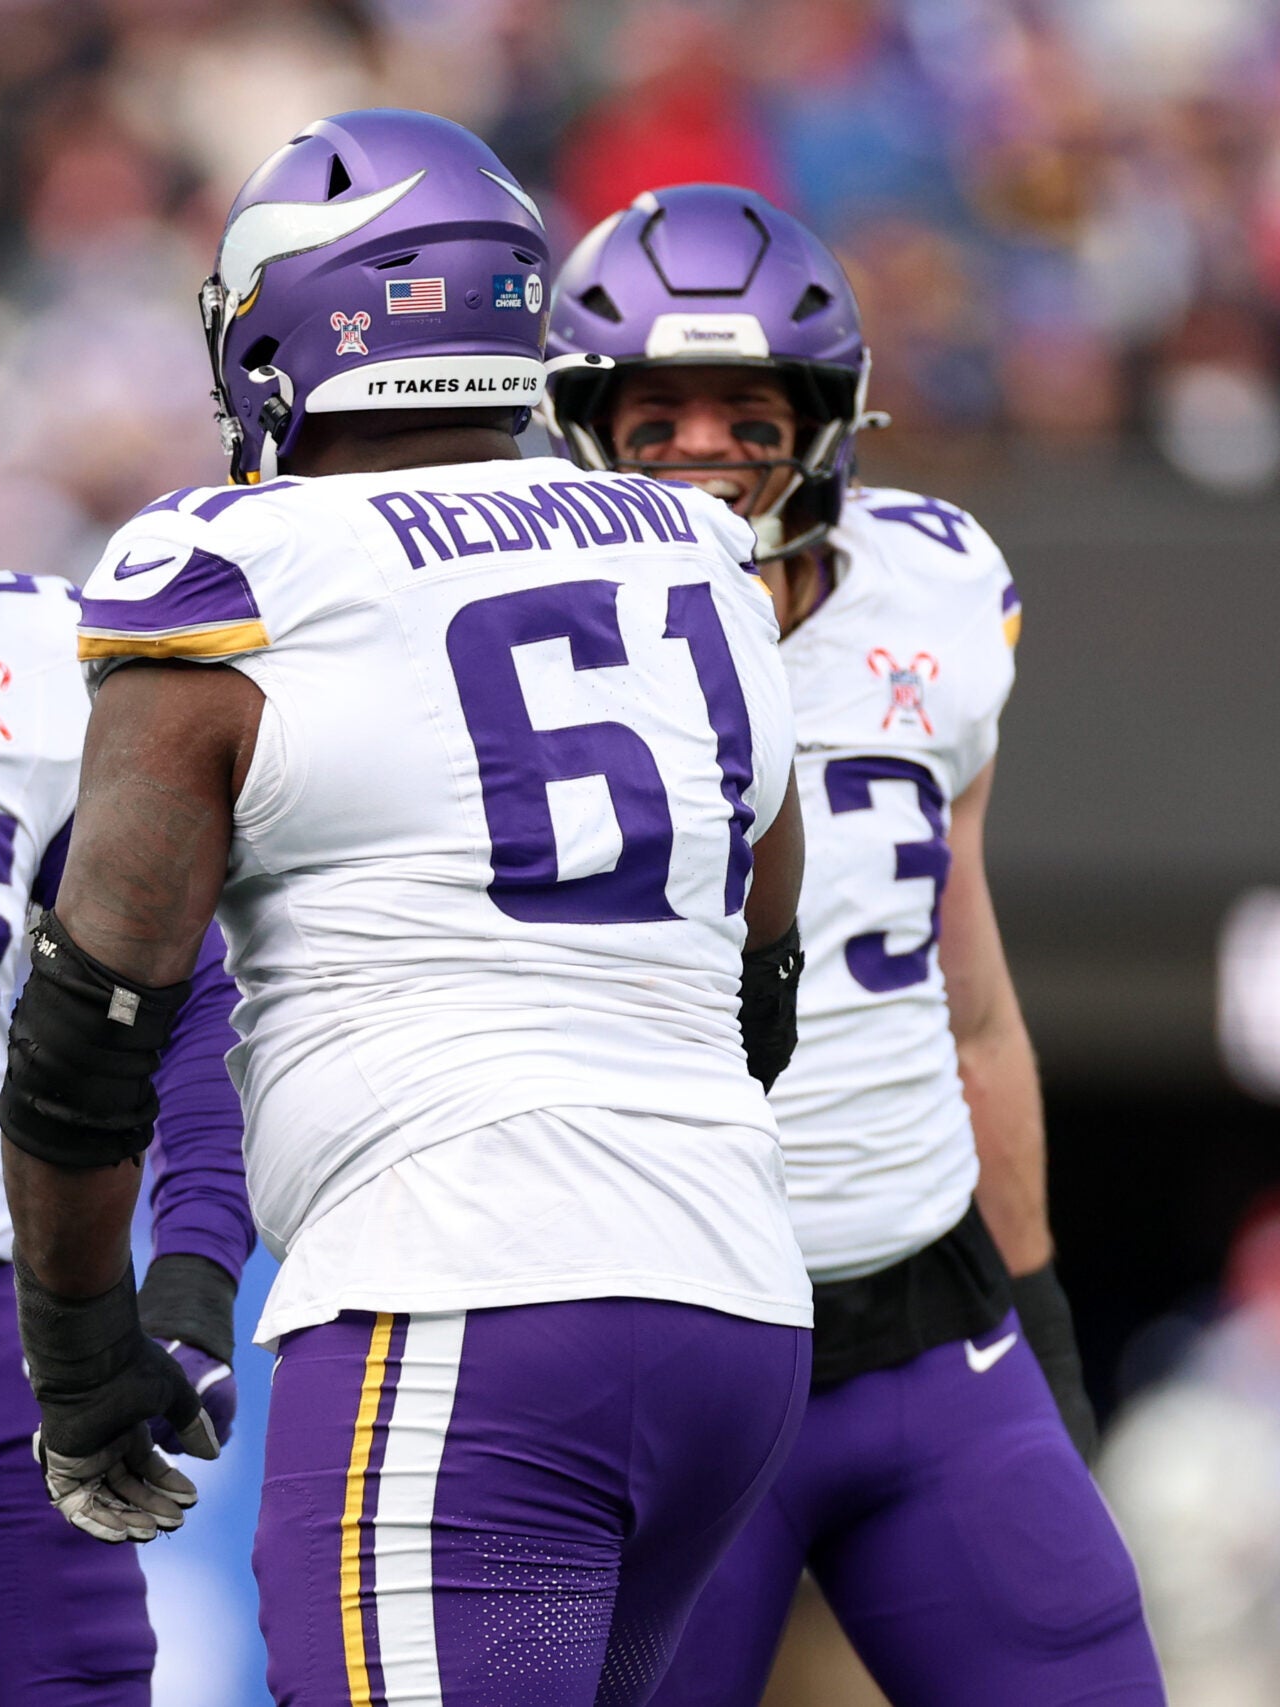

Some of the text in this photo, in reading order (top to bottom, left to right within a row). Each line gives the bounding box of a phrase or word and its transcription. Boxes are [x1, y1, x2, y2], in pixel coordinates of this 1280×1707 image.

[528, 282, 541, 305] 70
[368, 377, 537, 395] IT TAKES ALL OF US
[367, 478, 698, 570] REDMOND
[445, 578, 756, 925] 61
[824, 755, 952, 993] 3
